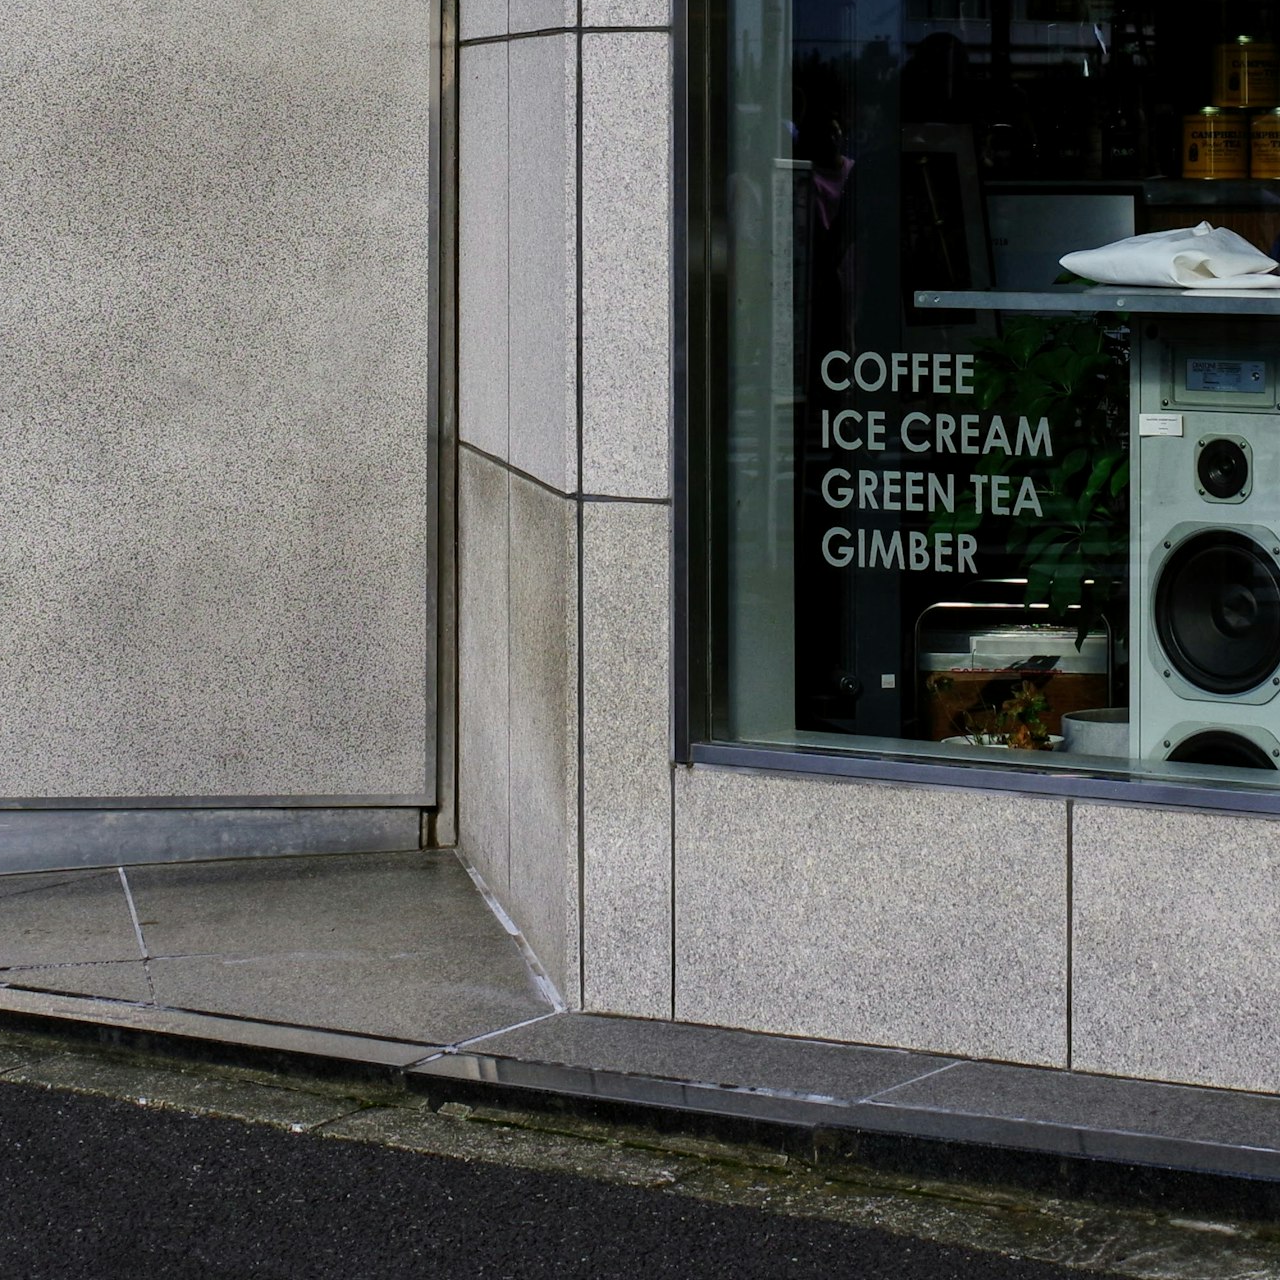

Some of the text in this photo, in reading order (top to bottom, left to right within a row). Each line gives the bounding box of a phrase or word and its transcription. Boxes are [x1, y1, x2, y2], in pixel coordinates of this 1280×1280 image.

[821, 350, 975, 394] COFFEE
[822, 410, 1054, 457] ICE CREAM
[821, 468, 1044, 517] GREEN TEA
[821, 526, 978, 574] GIMBER
